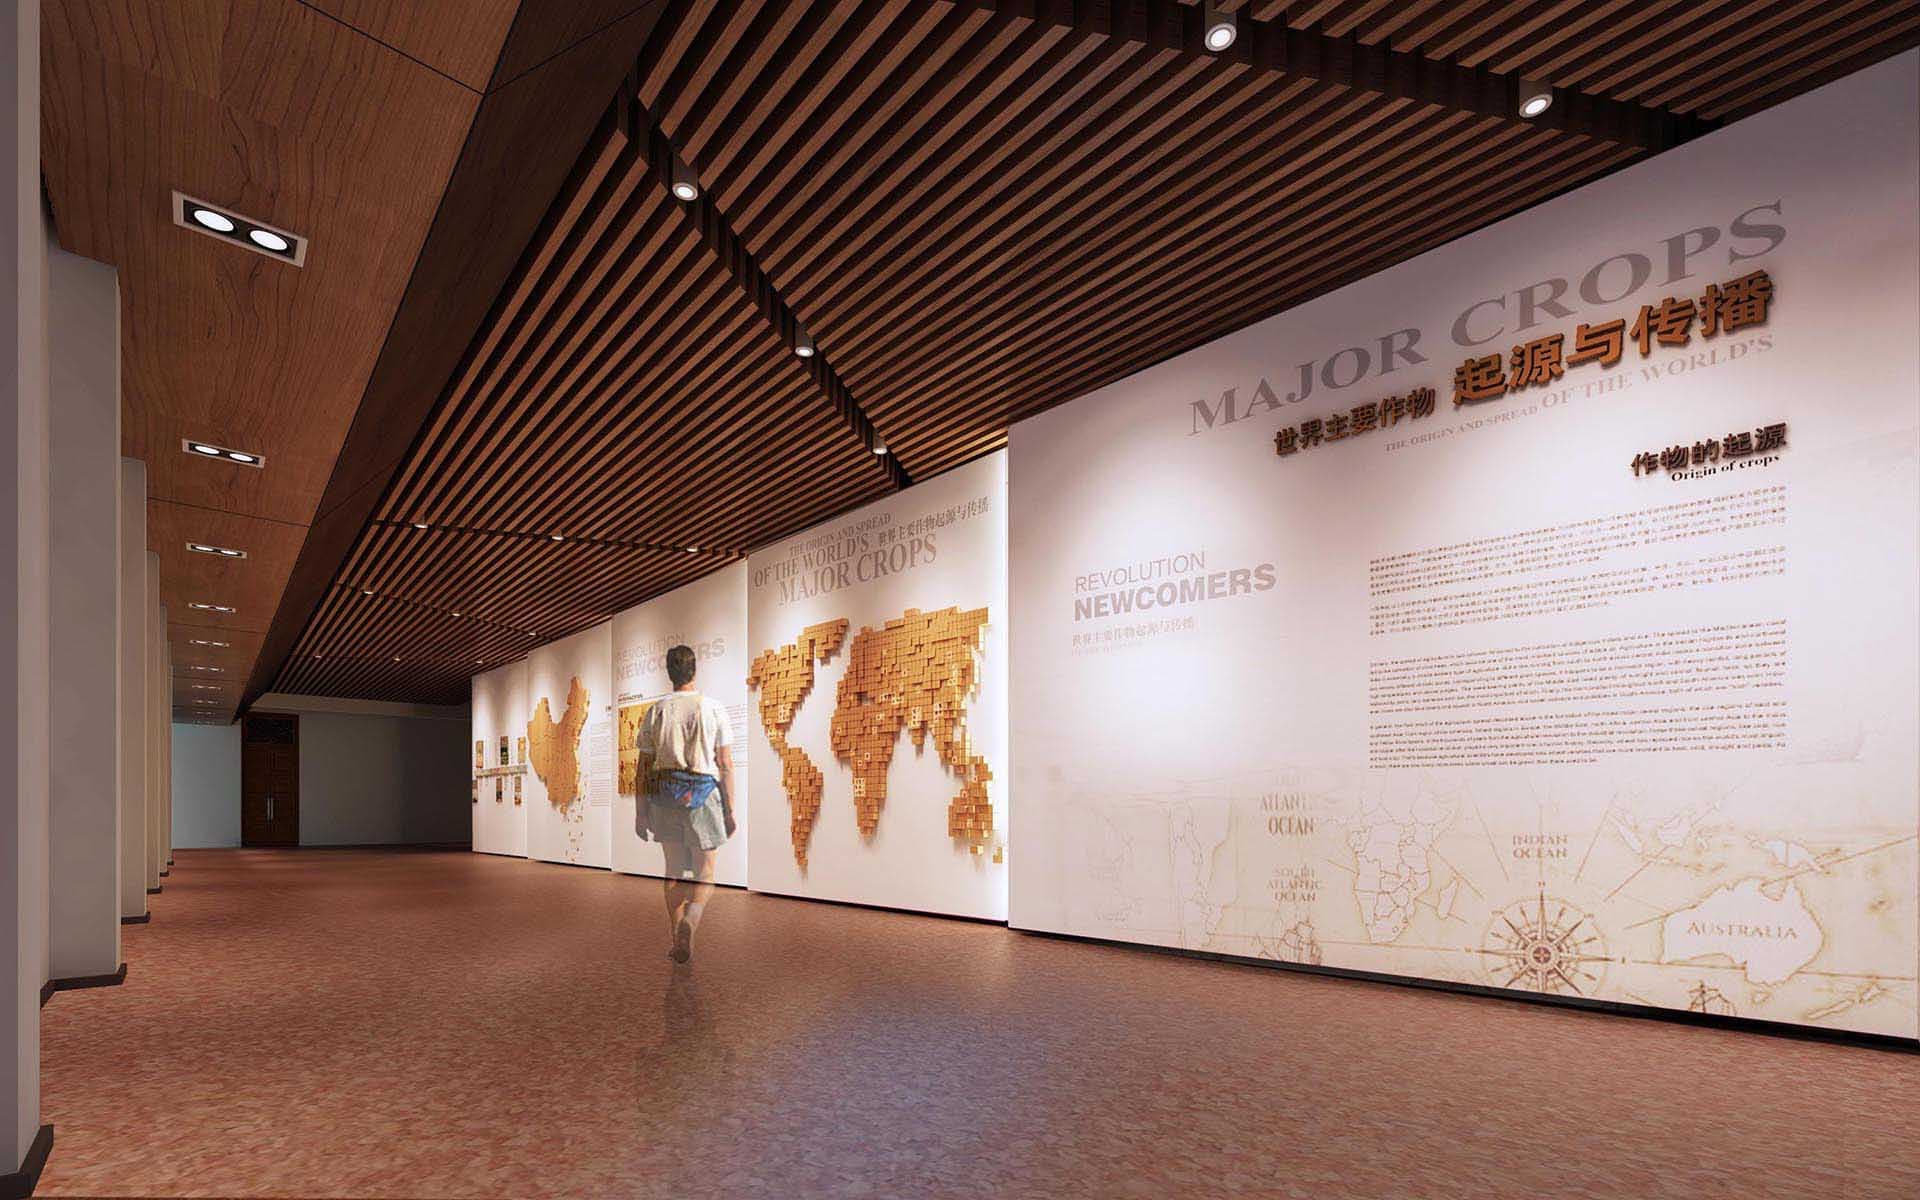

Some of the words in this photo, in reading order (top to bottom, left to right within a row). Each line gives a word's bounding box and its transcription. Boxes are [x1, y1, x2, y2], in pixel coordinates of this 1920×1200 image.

[1189, 328, 1428, 437] MAJOR
[1451, 200, 1786, 347] CROPS
[1274, 387, 1436, 456] 世界主要作物
[1453, 270, 1774, 404] 起源与传播
[1384, 439, 1409, 452] THE
[1410, 427, 1454, 446] ORIGIN
[1456, 419, 1484, 437] AND
[1485, 406, 1538, 432] SPREAD
[1542, 388, 1574, 408] OF
[1575, 372, 1633, 398] THE
[1640, 334, 1774, 384] WORLD'S
[1631, 422, 1787, 476] 作物的起源
[1671, 467, 1717, 482] Origin
[1721, 460, 1736, 472] of
[1739, 455, 1779, 470] crops
[754, 568, 773, 587] OF
[773, 558, 800, 581] THE
[803, 533, 869, 571] WORLD'S
[789, 542, 804, 556] THE
[805, 532, 835, 550] ORIGIN
[838, 526, 854, 540] AND
[855, 513, 891, 534] SPREAD
[778, 561, 850, 606] MAJOR
[857, 533, 938, 583] CROPS
[1074, 563, 1277, 622] NEWCOMERS
[1075, 552, 1205, 593] REVOLUTION
[1687, 921, 1798, 939] AUSTRALIA
